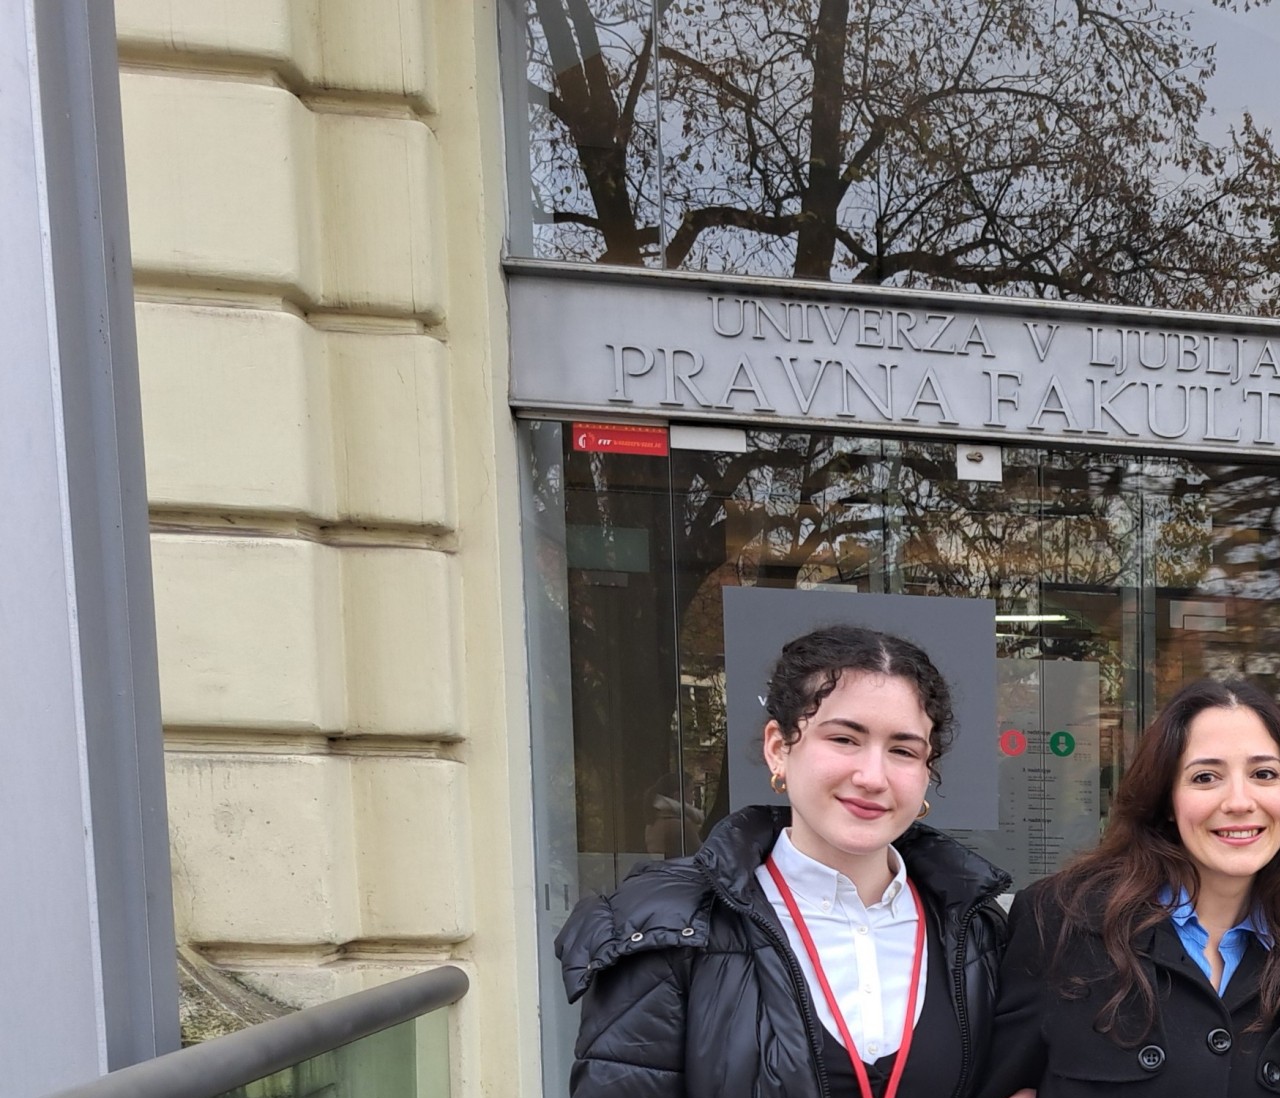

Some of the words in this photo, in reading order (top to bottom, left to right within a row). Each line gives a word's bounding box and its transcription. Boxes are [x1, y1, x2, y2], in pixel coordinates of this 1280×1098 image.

[708, 296, 996, 358] UNIVERZA
[1023, 321, 1060, 362] V
[605, 343, 960, 426] PRAVNA
